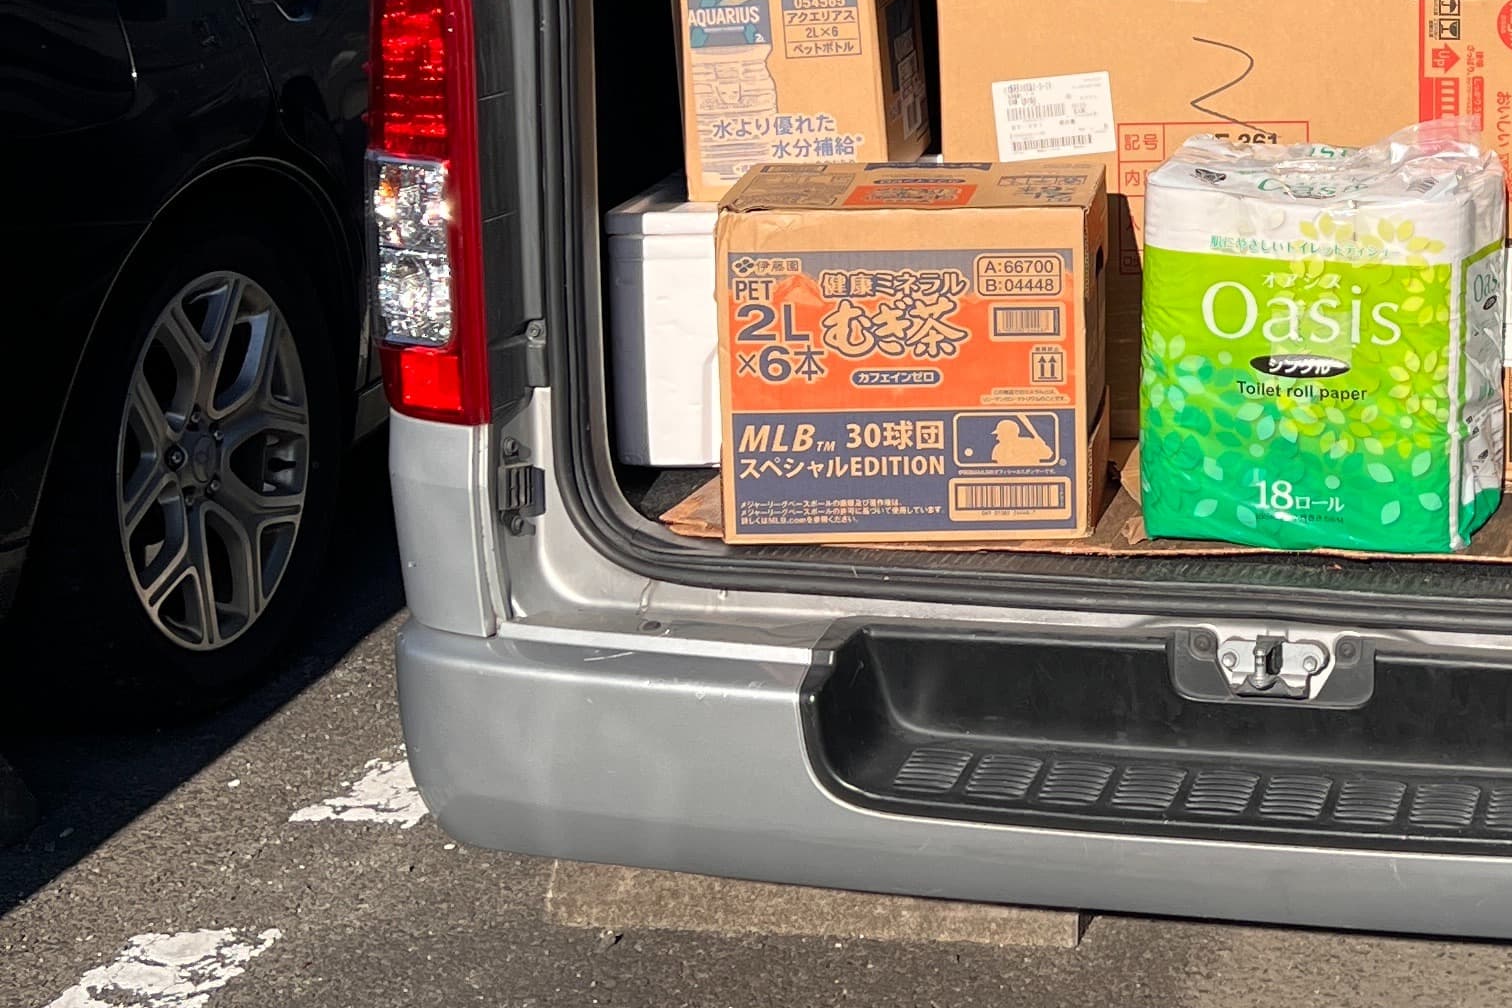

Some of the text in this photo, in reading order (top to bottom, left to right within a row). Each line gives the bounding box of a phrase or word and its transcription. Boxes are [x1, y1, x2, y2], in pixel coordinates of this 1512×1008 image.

[687, 6, 761, 26] AQUARIUS
[786, 9, 856, 24] アクエリアス
[792, 42, 855, 55] ペットボトル
[712, 113, 836, 140] 水より優れた
[1496, 91, 1512, 148] おいしい
[1123, 133, 1160, 151] 記号
[755, 259, 800, 273] 伊藤園
[984, 260, 1054, 274] A:66700
[735, 279, 773, 300] PET
[820, 271, 968, 299] 健康ミネラル
[985, 278, 1055, 293] B:04448
[1263, 272, 1342, 290] オアシス
[737, 304, 811, 343] 2L
[1201, 280, 1403, 347] Oasis
[820, 294, 970, 359] むぎ茶
[856, 372, 936, 384] カフェインゼロ
[1236, 380, 1368, 402] Toilet roll paper
[845, 420, 945, 451] 30球団
[739, 454, 946, 480] スペシャルEDITION
